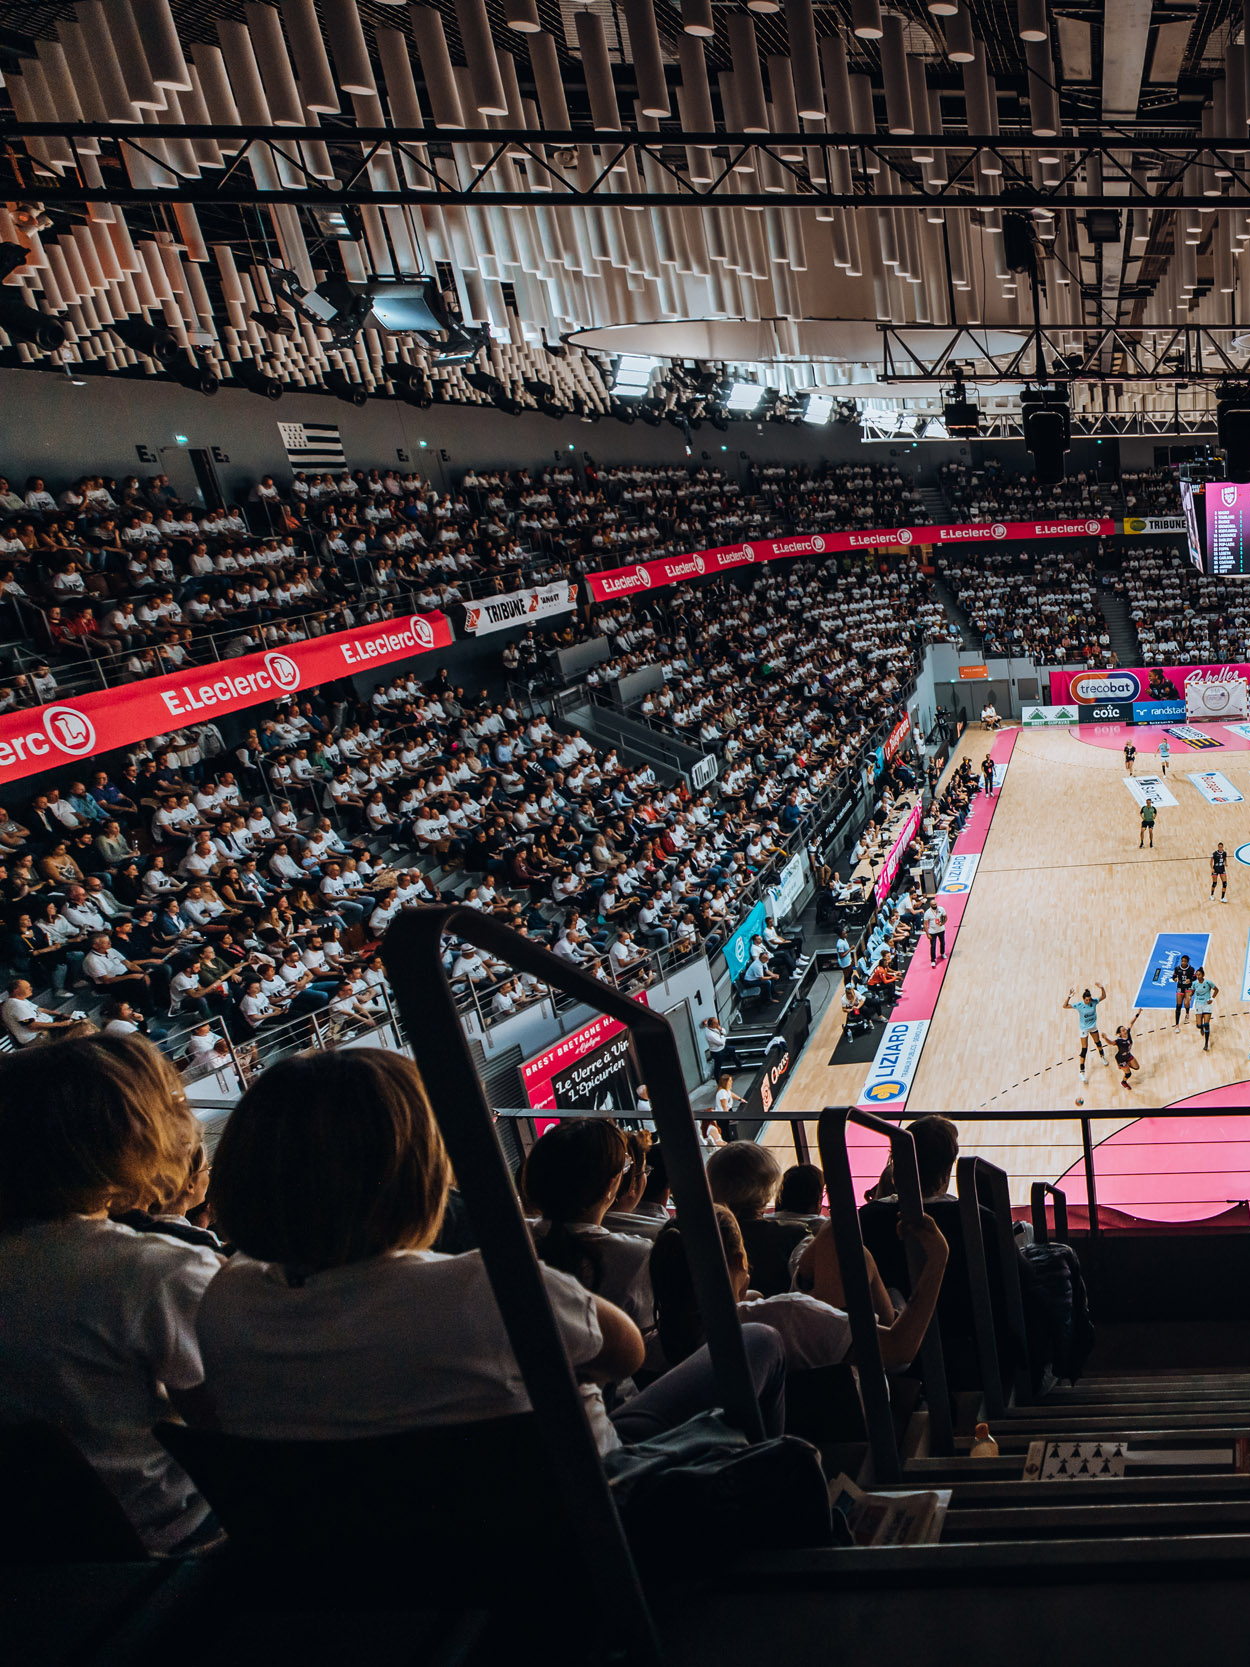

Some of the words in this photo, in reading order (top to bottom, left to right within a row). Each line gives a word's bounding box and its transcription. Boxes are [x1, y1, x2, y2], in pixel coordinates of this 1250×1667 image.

[211, 446, 230, 463] E2
[940, 527, 990, 539] E.Leclerc
[1035, 524, 1084, 536] E.Leclerc
[1149, 519, 1187, 530] TRIBUNE
[772, 542, 812, 554] E.Leclerc
[849, 533, 897, 546] E.Leclerc
[717, 551, 745, 564] E.Leclerc
[665, 562, 696, 578] E.Leclerc
[601, 575, 640, 593] E.Leclerc
[485, 598, 527, 623] TRIBUNE
[340, 631, 415, 664] E.Leclerc
[161, 669, 272, 716] E.Leclerc
[1080, 682, 1131, 694] trecobat
[1151, 705, 1186, 716] randstad
[947, 855, 967, 882] LIZIARD
[694, 989, 702, 1006] 1
[525, 1053, 554, 1077] BREST
[557, 1025, 601, 1056] BRETAGNE
[875, 1024, 909, 1078] LIZIARD
[556, 1080, 572, 1094] Le
[572, 1059, 603, 1082] Verre
[604, 1053, 612, 1063] à
[568, 1058, 625, 1102] L'Epicurien
